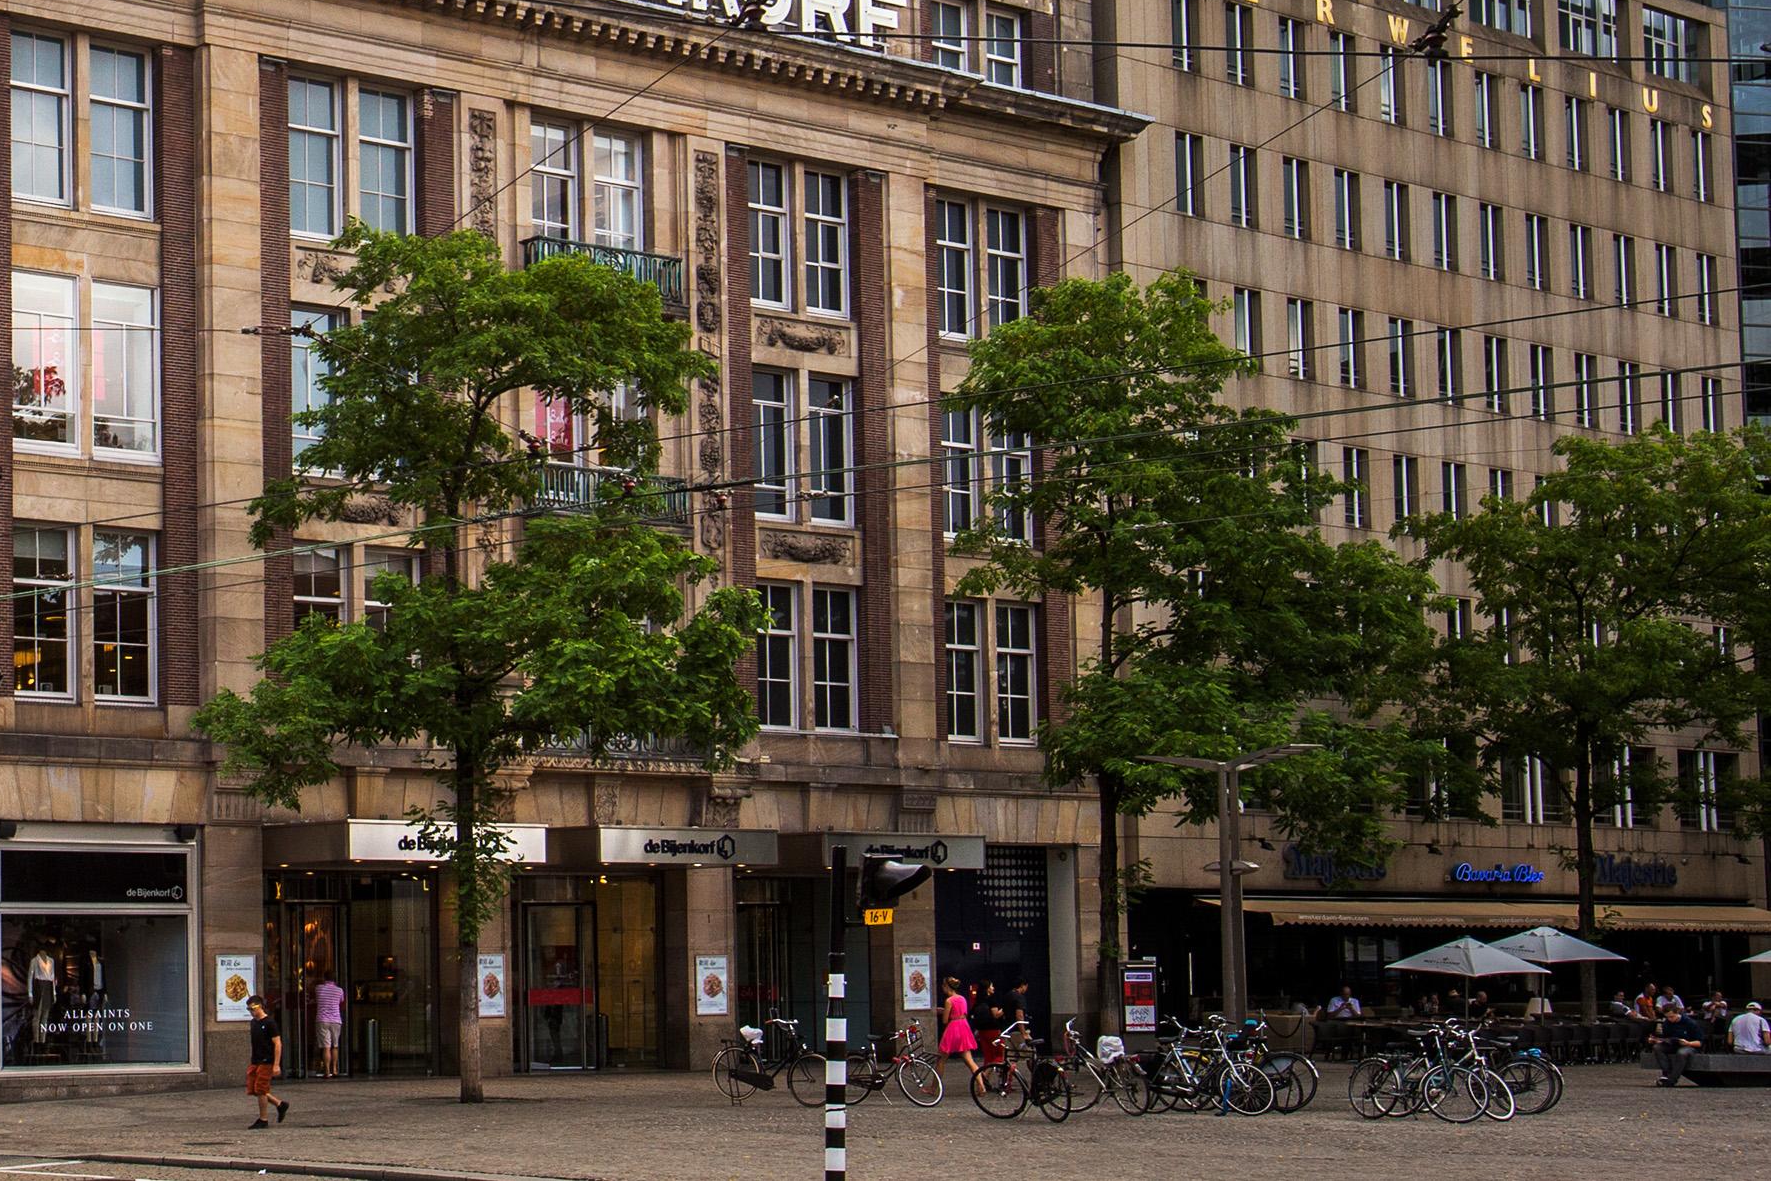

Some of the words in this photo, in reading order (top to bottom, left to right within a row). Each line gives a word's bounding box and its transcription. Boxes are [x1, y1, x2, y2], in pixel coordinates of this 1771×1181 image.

[1456, 862, 1512, 882] Bavaria
[870, 910, 889, 923] 16-V
[63, 1008, 131, 1019] ALLSAINTS
[40, 1023, 68, 1033] NOW
[72, 1022, 104, 1033] OPEN
[108, 1021, 125, 1032] ON
[129, 1021, 154, 1031] ONE
